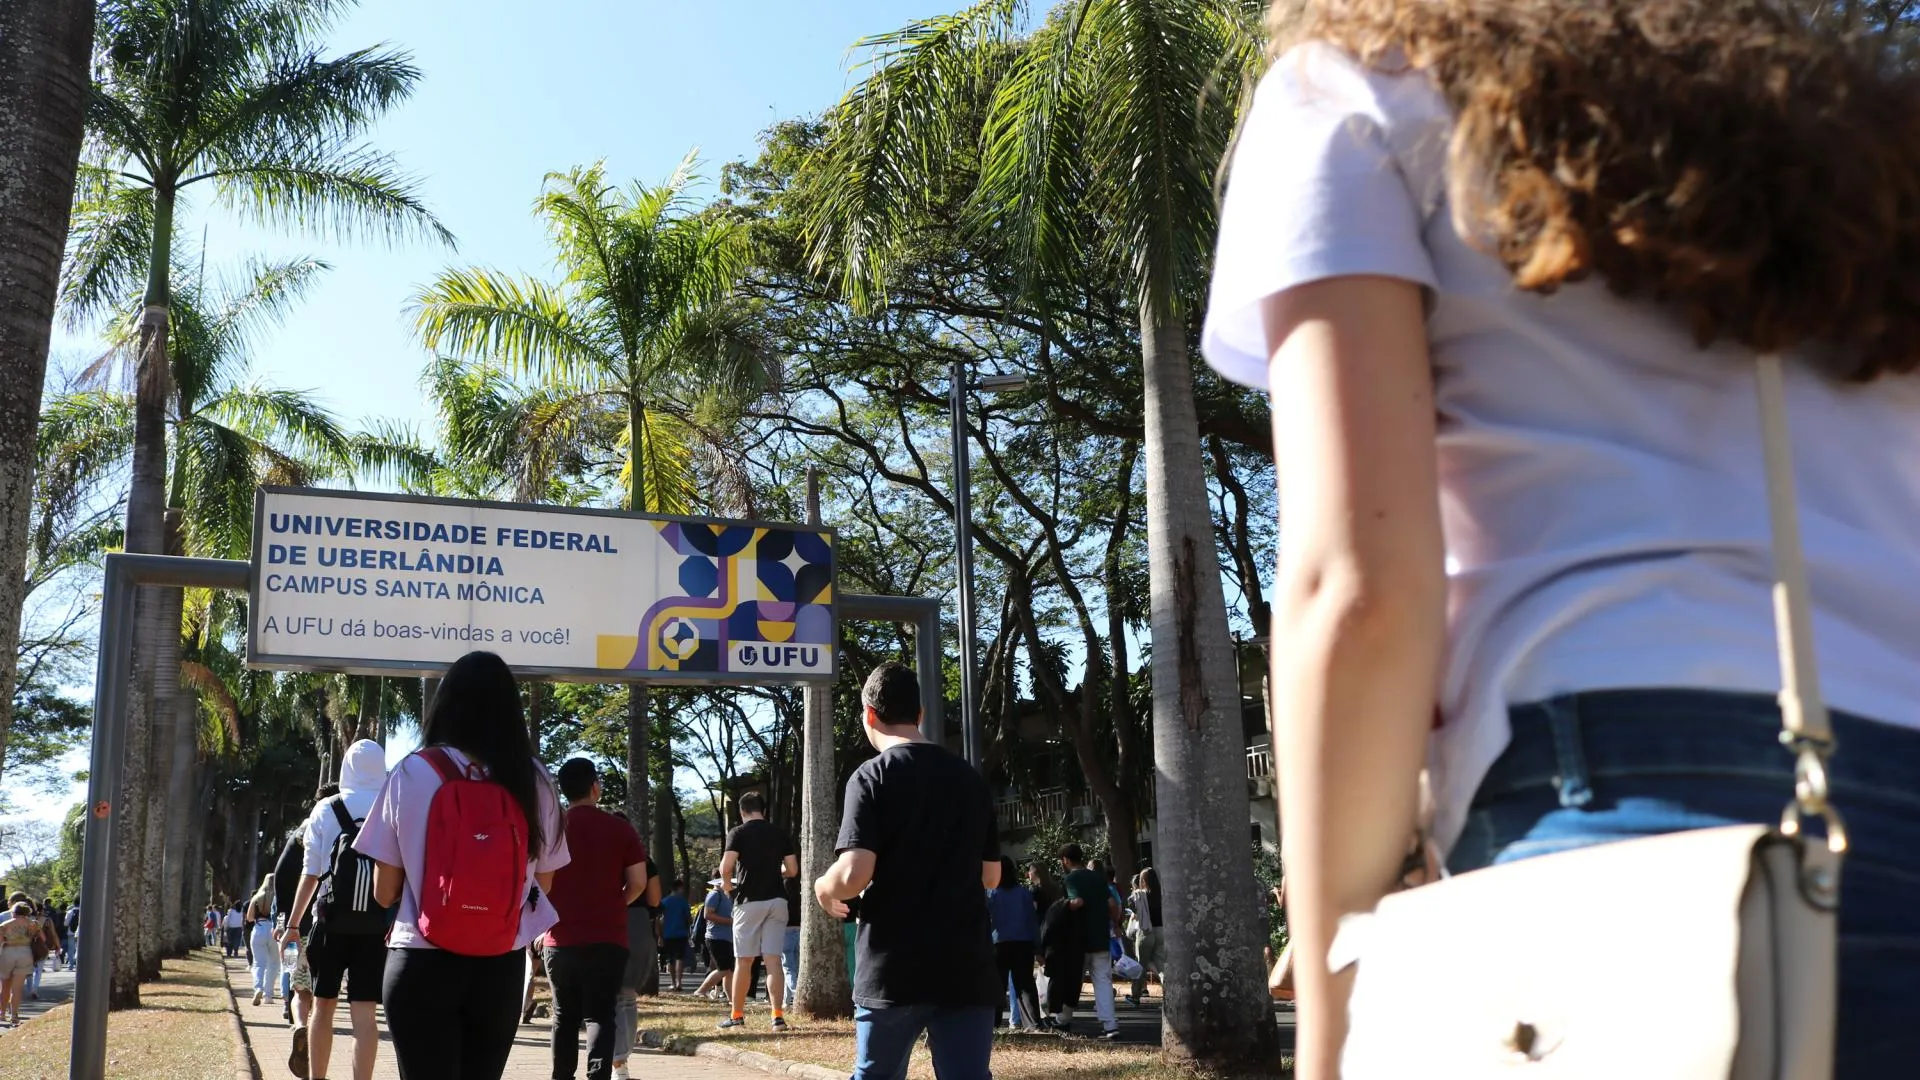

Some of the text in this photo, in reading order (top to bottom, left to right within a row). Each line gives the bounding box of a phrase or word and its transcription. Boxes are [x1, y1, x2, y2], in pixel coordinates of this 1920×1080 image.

[270, 513, 618, 554] UNIVERSIDADE FEDERAL
[268, 544, 504, 576] DE UBERLÂNDIA
[266, 574, 545, 604] CAMPUS SANTA MÔNICA
[264, 616, 570, 645] A UFU dá boas-vindas a você!
[763, 646, 818, 667] UFU
